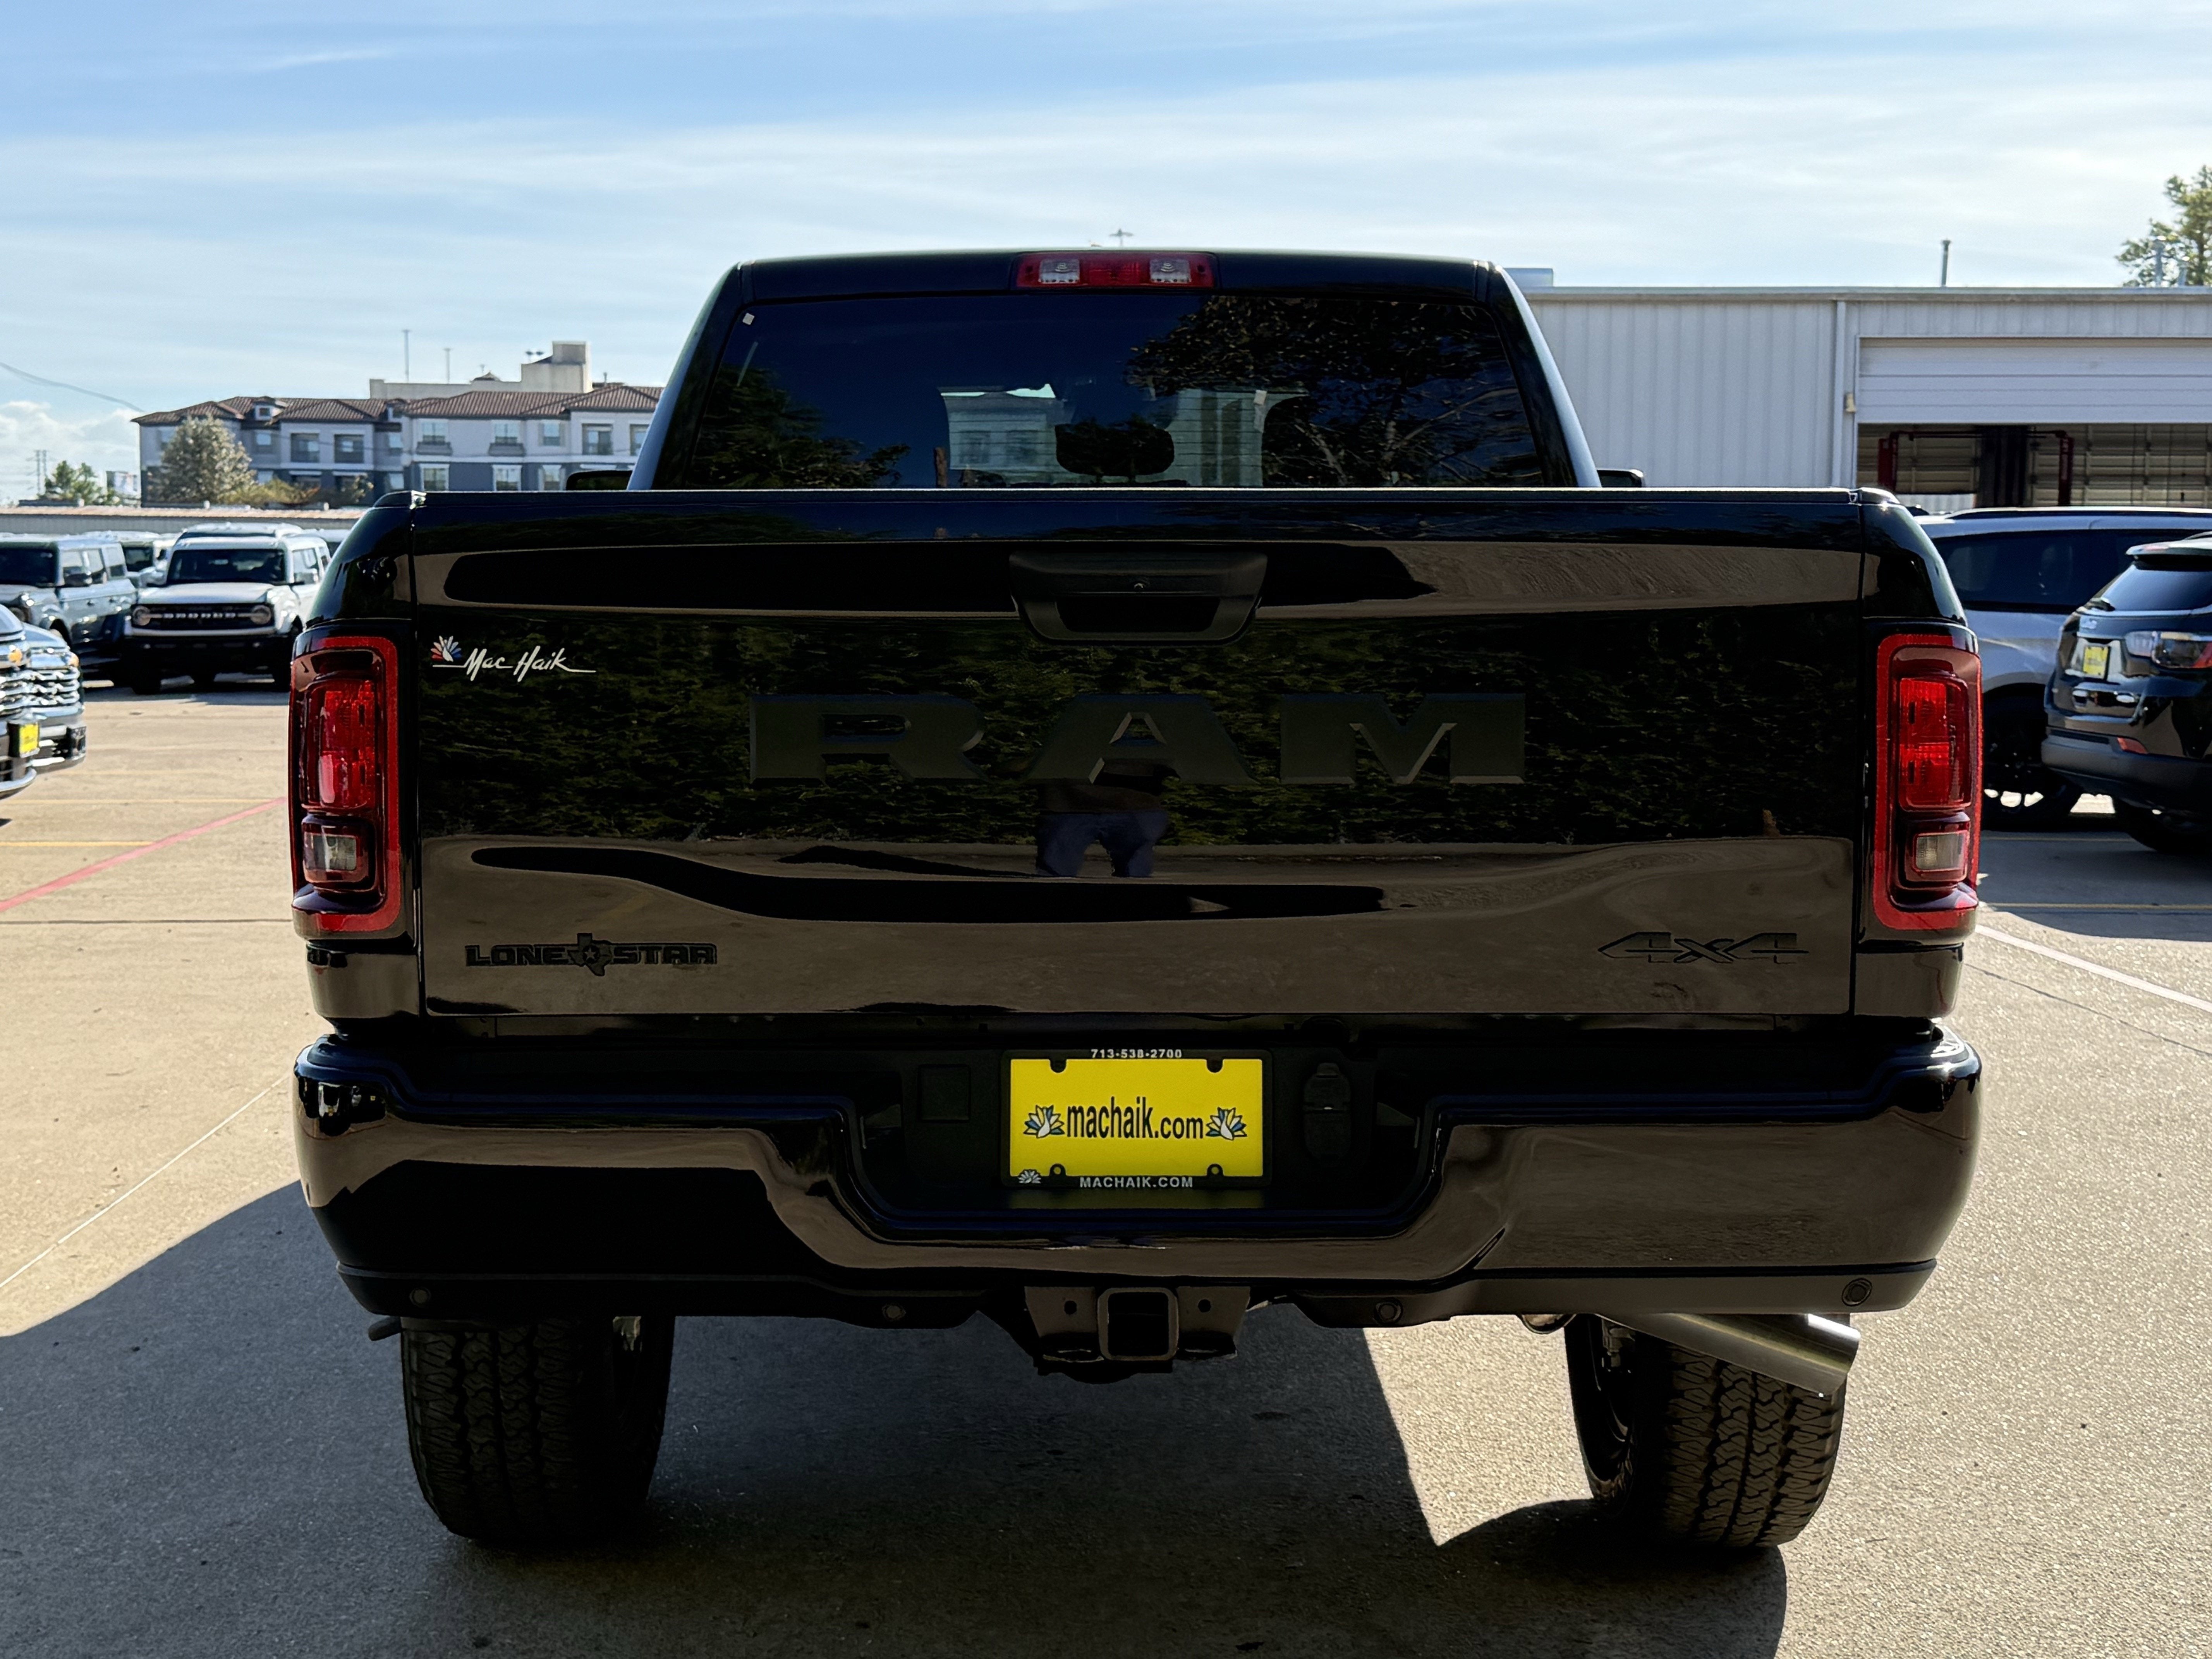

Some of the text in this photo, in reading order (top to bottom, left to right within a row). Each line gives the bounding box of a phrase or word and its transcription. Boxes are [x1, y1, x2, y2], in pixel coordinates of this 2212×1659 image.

[433, 646, 596, 682] Mac Haik
[750, 693, 1525, 785] RAM
[465, 943, 717, 967] LONE STAR
[1067, 1096, 1203, 1139] machaik.com
[1080, 1176, 1193, 1188] MACHAIK.COM
